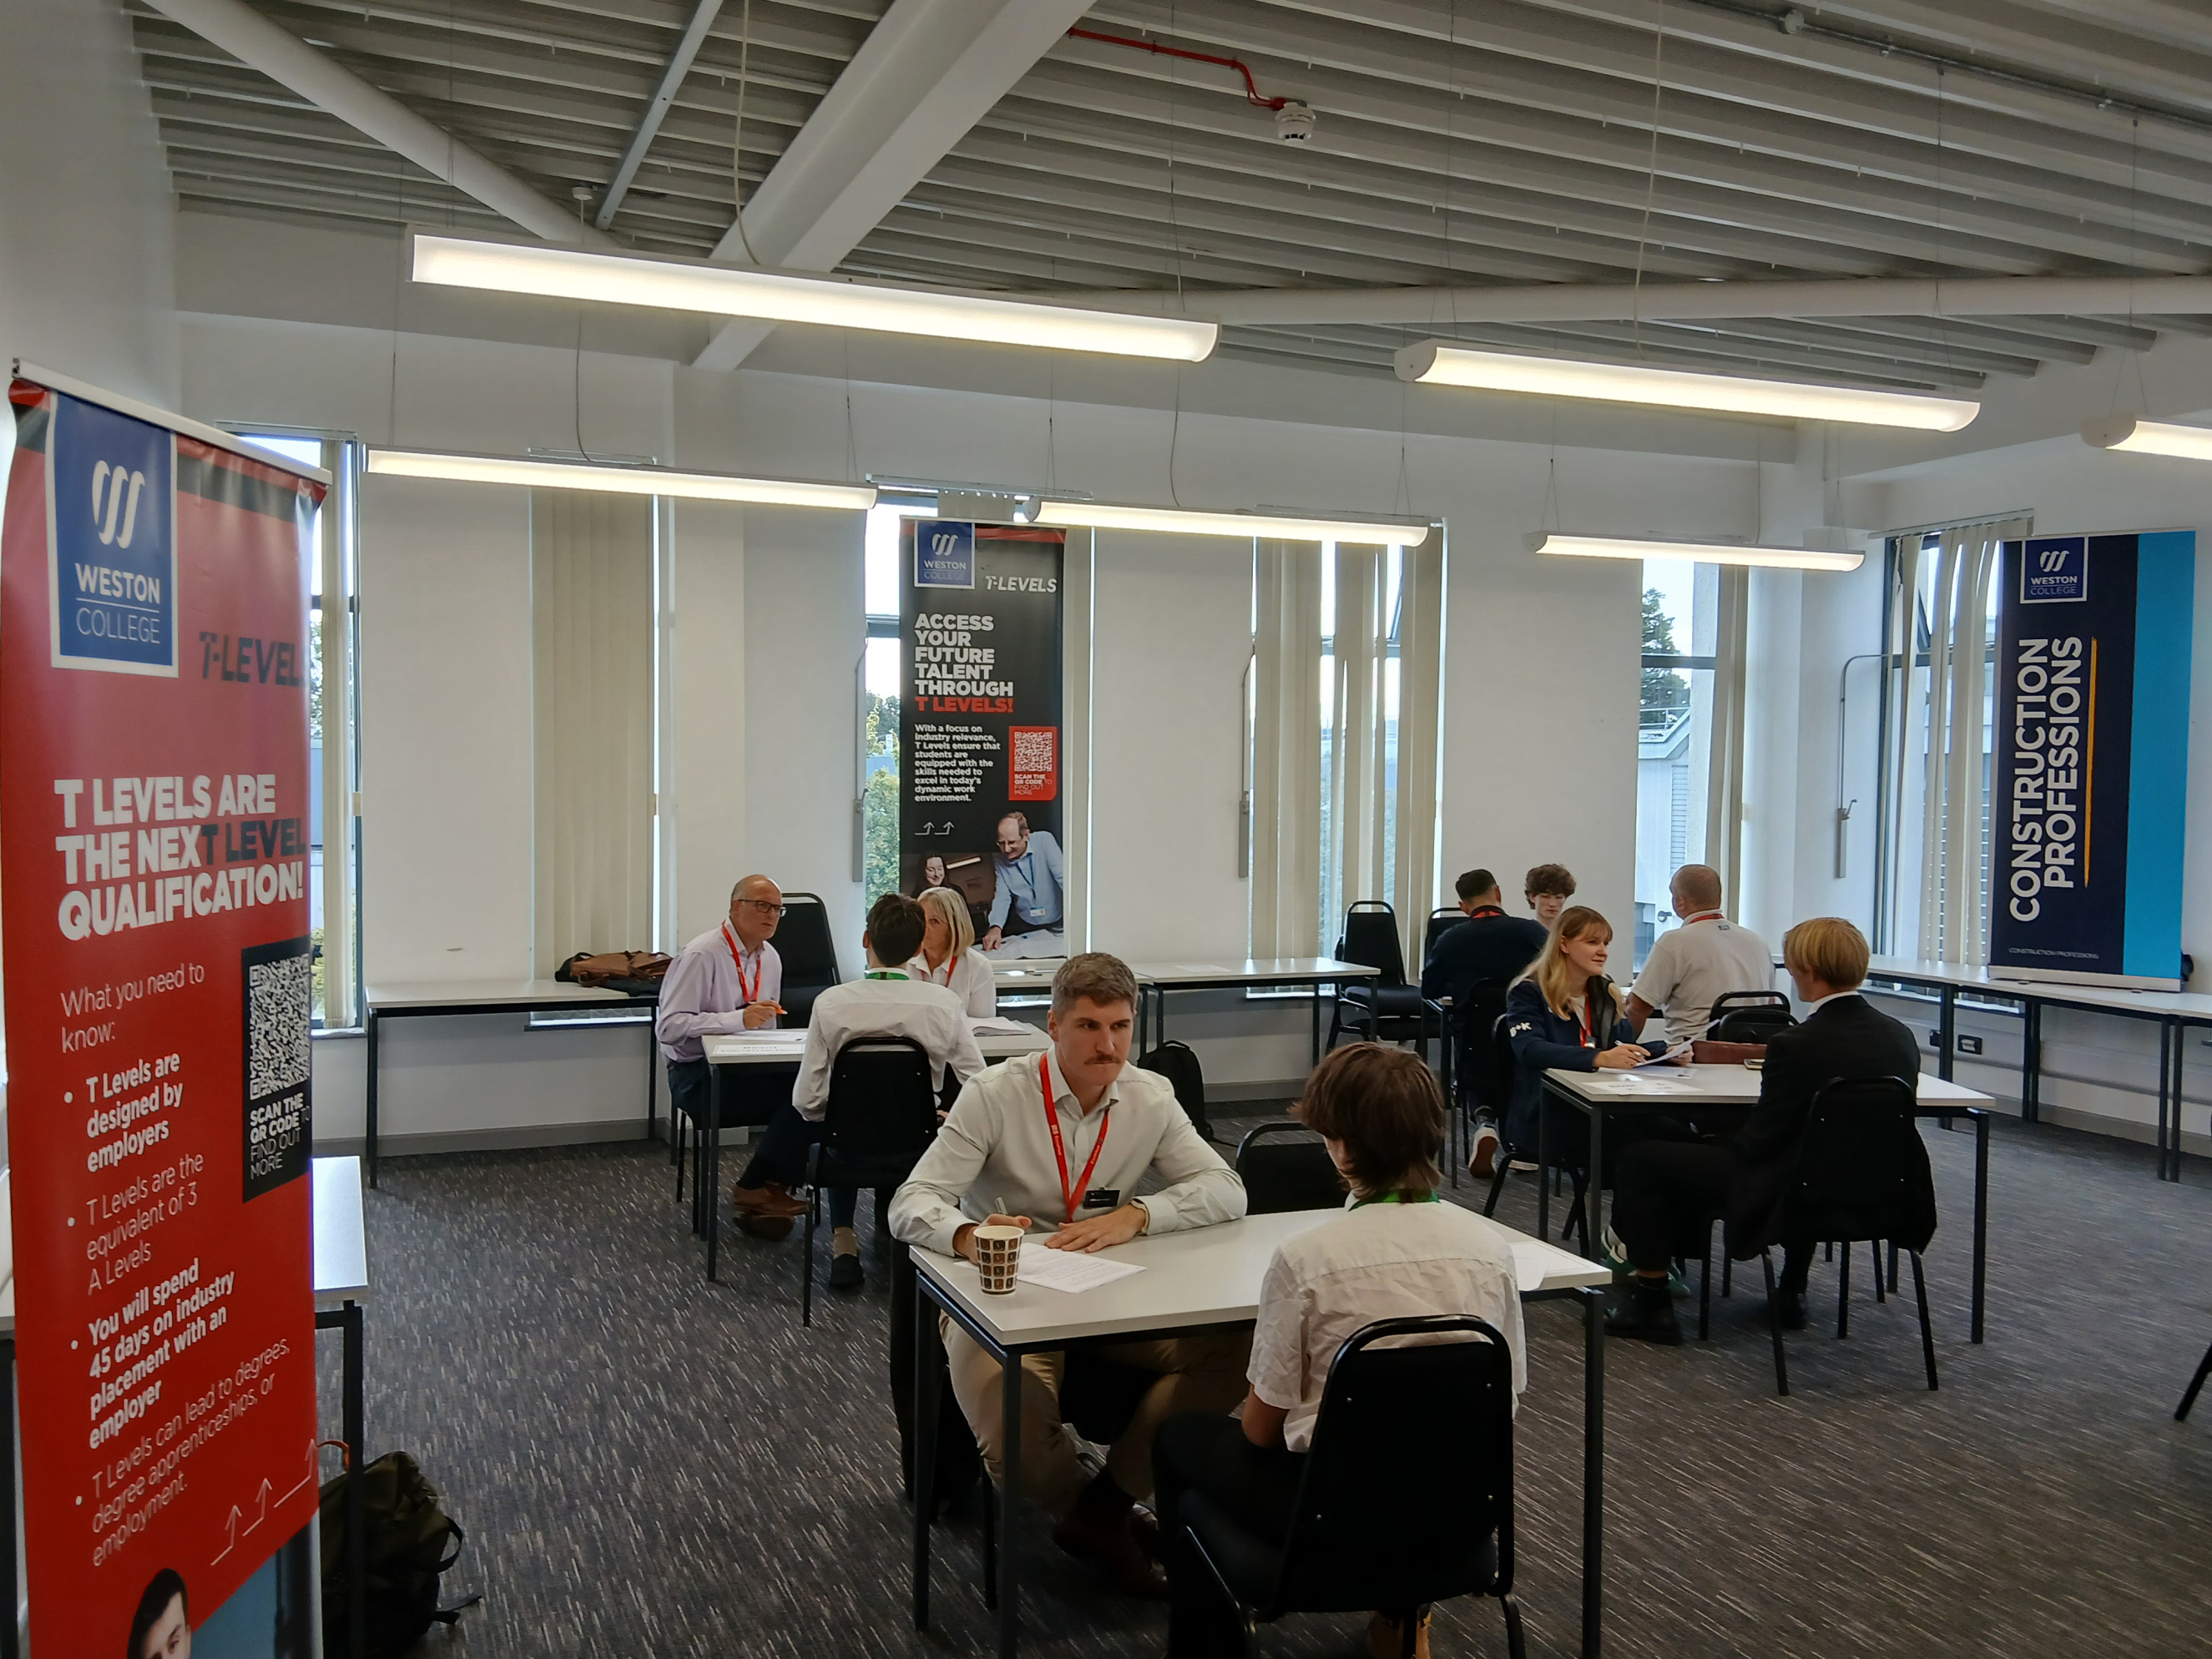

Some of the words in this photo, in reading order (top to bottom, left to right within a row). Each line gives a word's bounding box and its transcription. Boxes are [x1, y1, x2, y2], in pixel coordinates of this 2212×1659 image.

[924, 560, 967, 570] WESTON
[924, 571, 966, 581] COLLEGE
[2030, 576, 2078, 585] WESTON
[75, 563, 160, 604] WESTON
[986, 576, 1058, 593] T-LEVELS
[2030, 586, 2077, 595] COLLEGE
[75, 607, 161, 644] COLLEGE
[915, 613, 994, 631] ACCESS
[915, 630, 972, 647] YOUR
[915, 647, 995, 663] FUTURE
[915, 663, 993, 680] TALENT
[915, 680, 1013, 696] THROUGH
[915, 697, 928, 712] T
[932, 697, 1014, 714] LEVELS!
[914, 724, 937, 733] With
[946, 724, 969, 733] focus
[952, 734, 996, 742] relevance,
[915, 750, 952, 759] students
[915, 759, 957, 768] equipped
[2043, 636, 2083, 889] PROFESSIONS
[915, 785, 952, 794] dynamic
[953, 784, 976, 793] work
[2009, 638, 2049, 922] CONSTRUCTION
[54, 779, 83, 828] T
[93, 775, 212, 825] LEVELS
[217, 774, 276, 817] ARE
[55, 831, 130, 885] THE
[225, 817, 306, 863] LEVEL
[58, 861, 304, 941] QUALIFICATION!
[60, 983, 112, 1017] What
[116, 980, 144, 1010] you
[147, 963, 184, 995] need
[189, 962, 205, 985] to
[62, 1021, 115, 1053] know:
[86, 1077, 98, 1103] T
[103, 1058, 151, 1099] Levels
[155, 1052, 180, 1076] are
[87, 1087, 159, 1138] designed
[163, 1082, 184, 1108] by
[250, 1102, 281, 1127] SCAN
[283, 1092, 304, 1113] THE
[87, 1119, 169, 1172] employers
[250, 1125, 267, 1144] QR
[269, 1112, 300, 1136] CODE
[250, 1138, 276, 1162] FIND
[279, 1127, 301, 1149] OUT
[251, 1152, 283, 1179] MORE
[86, 1198, 98, 1226] T
[103, 1176, 149, 1219] Levels
[152, 1166, 176, 1193] are
[179, 1152, 205, 1183] the
[87, 1201, 164, 1262] equivalent
[168, 1191, 185, 1218] of
[187, 1181, 198, 1207] 3
[88, 1267, 102, 1296] A
[105, 1241, 152, 1286] Levels
[88, 1311, 119, 1346] You
[122, 1287, 149, 1324] will
[153, 1257, 199, 1305] spend
[89, 1346, 111, 1379] 45
[114, 1321, 150, 1364] days
[153, 1306, 174, 1335] on
[176, 1270, 235, 1321] industry
[90, 1339, 170, 1420] placement
[173, 1315, 206, 1354] with
[210, 1306, 227, 1331] an
[89, 1379, 162, 1449] employer
[93, 1471, 103, 1498] T
[108, 1435, 152, 1488] Levels
[156, 1414, 182, 1446] can
[185, 1384, 215, 1424] lead
[219, 1378, 232, 1399] to
[93, 1475, 145, 1533] degree
[260, 1373, 275, 1394] or
[93, 1471, 188, 1566] employment.
